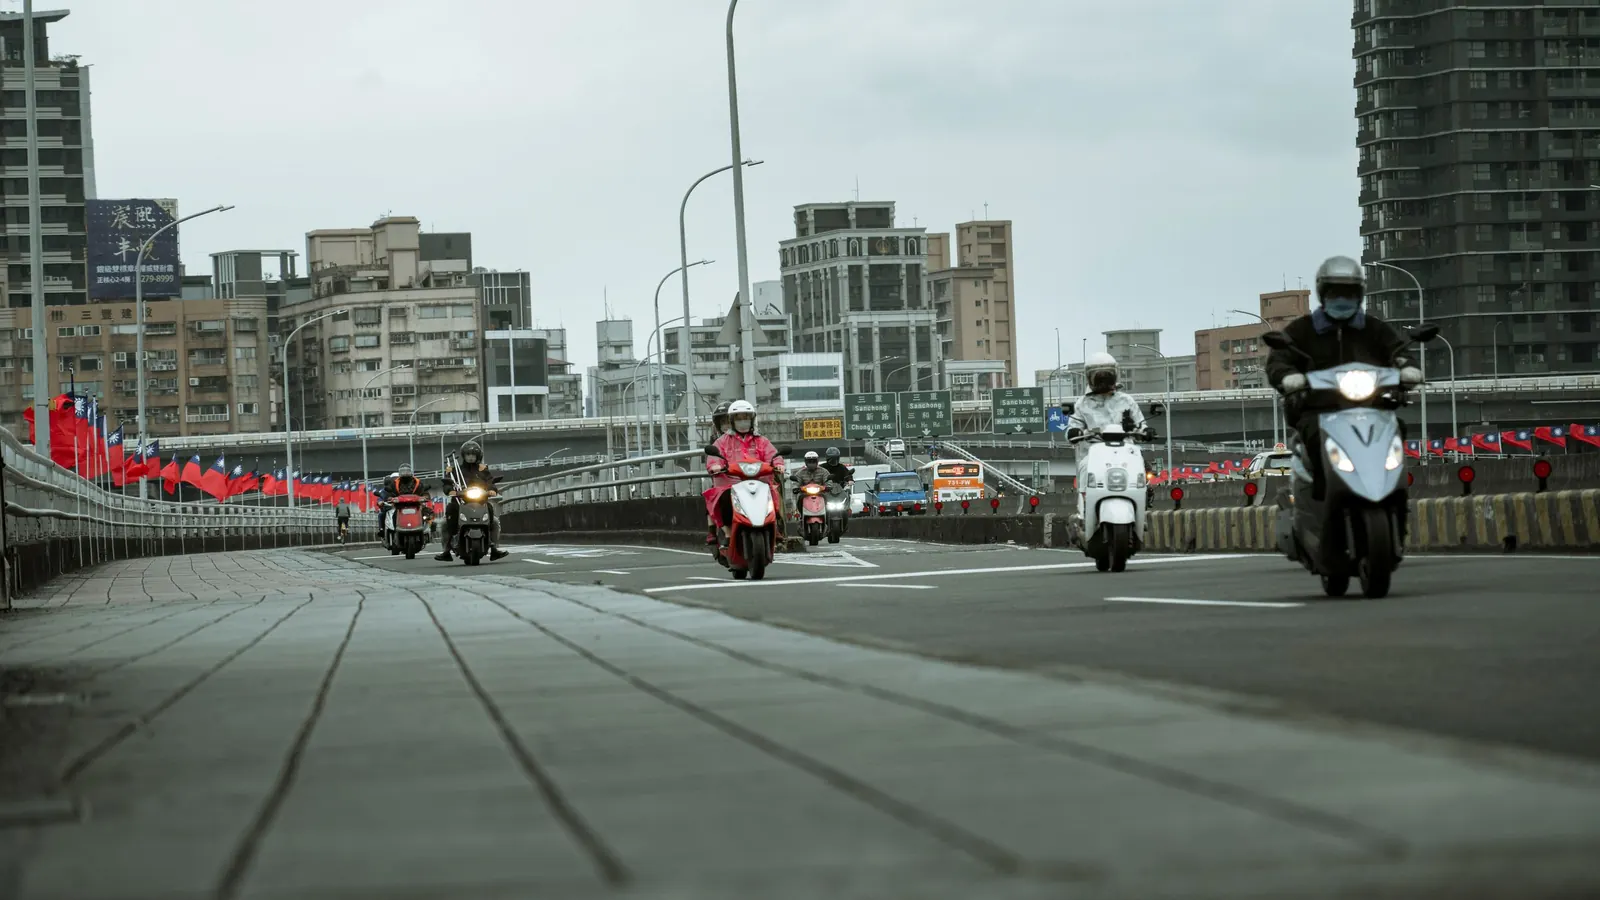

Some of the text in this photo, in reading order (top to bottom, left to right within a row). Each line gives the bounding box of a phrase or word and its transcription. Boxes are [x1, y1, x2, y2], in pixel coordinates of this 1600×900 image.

[137, 274, 174, 283] 279-8999
[912, 392, 938, 401] 三重
[1005, 389, 1031, 397] 三重
[857, 395, 883, 403] 三重
[909, 402, 942, 410] Sanchong
[907, 411, 944, 419] 三和路
